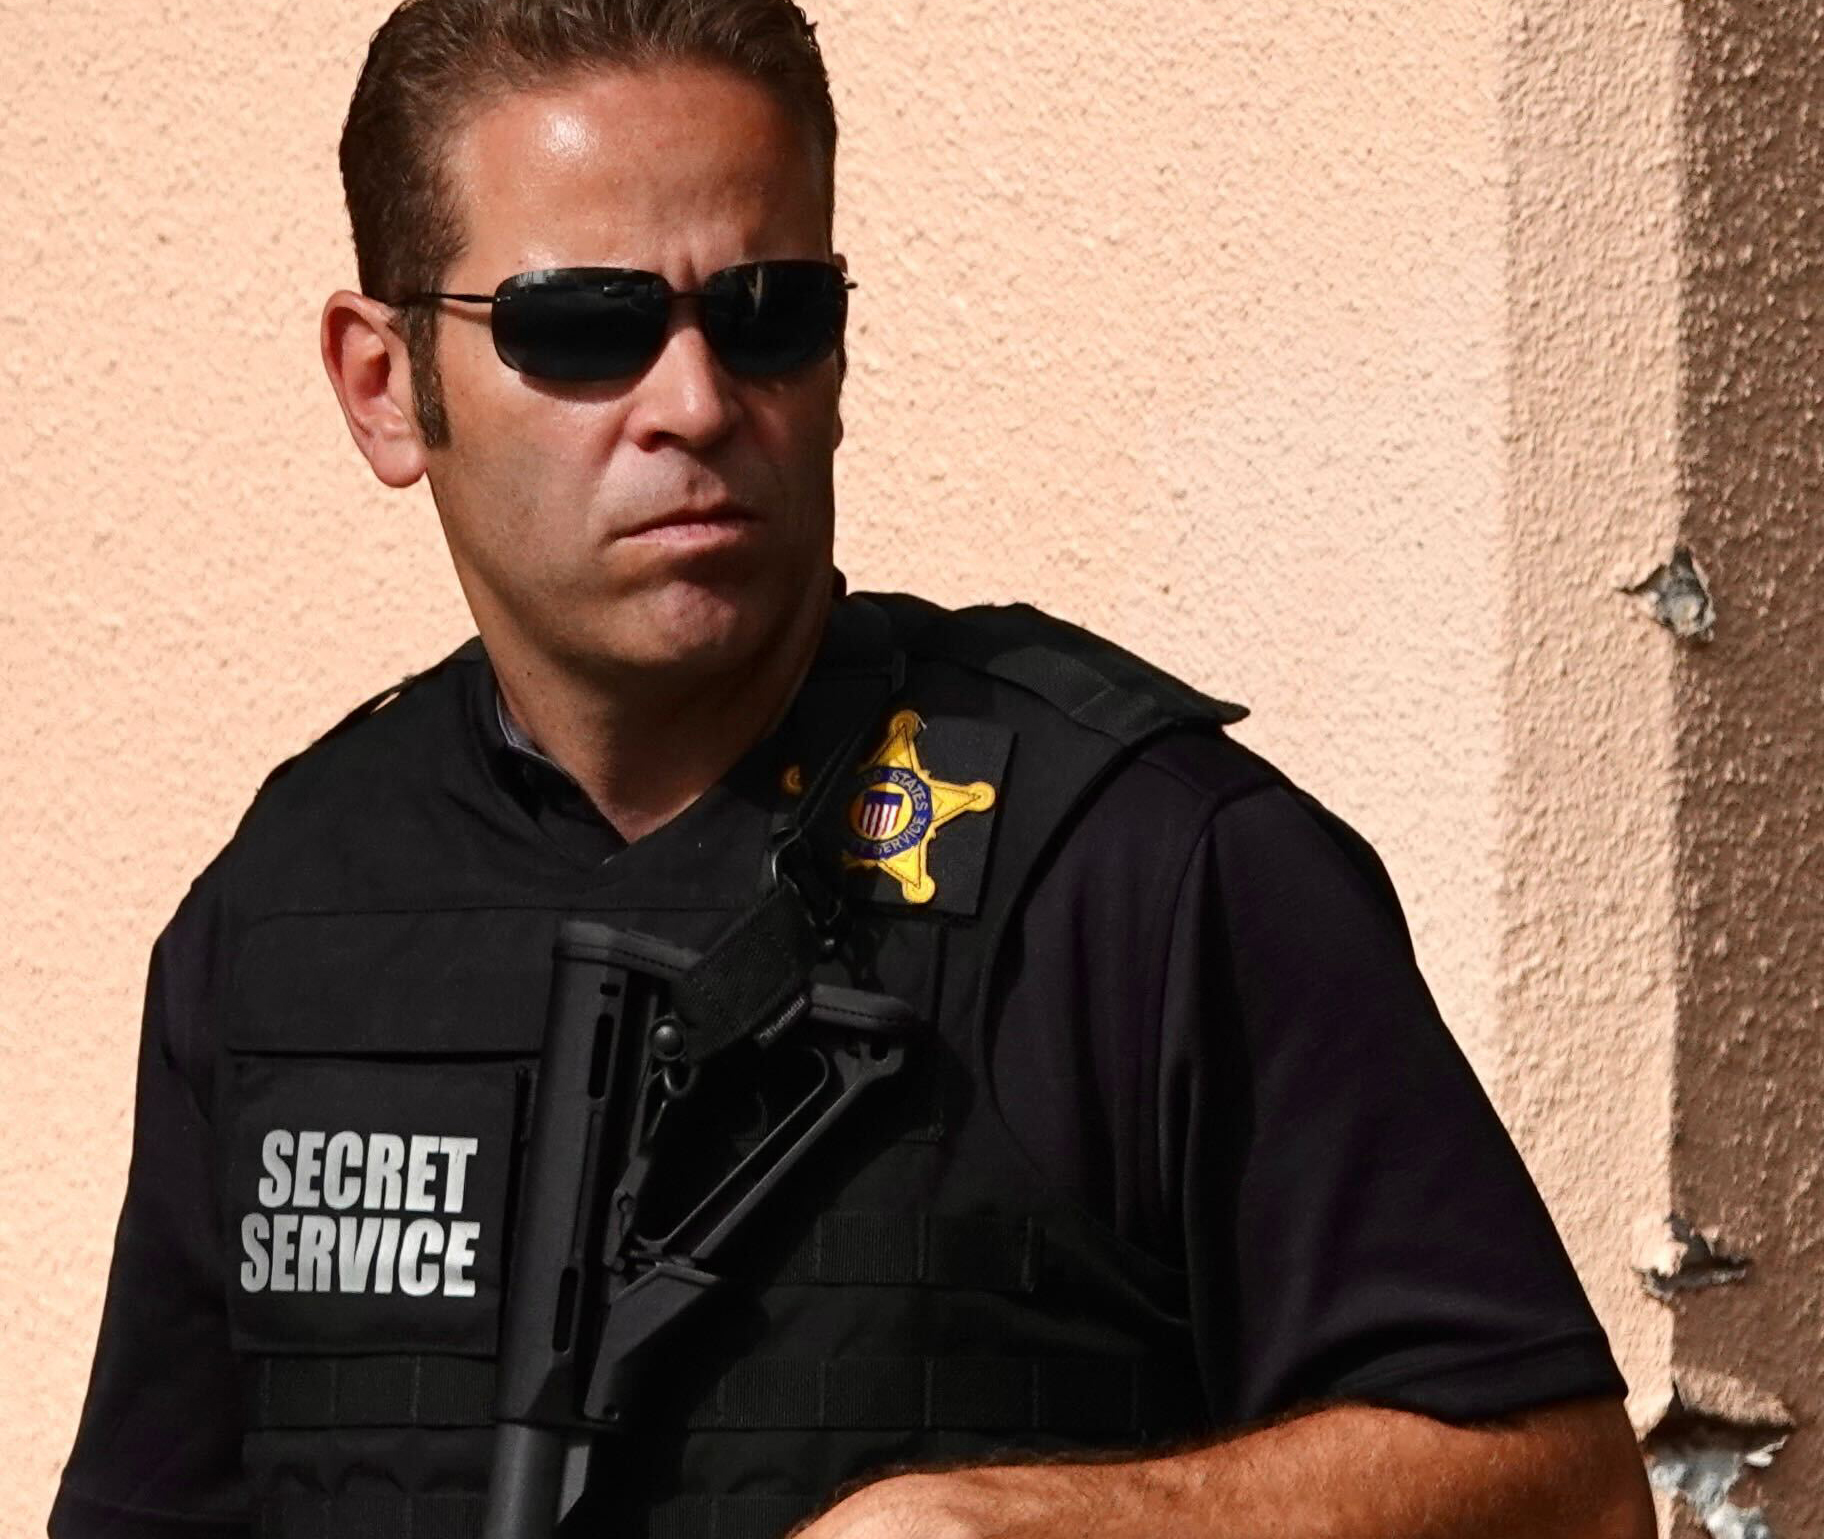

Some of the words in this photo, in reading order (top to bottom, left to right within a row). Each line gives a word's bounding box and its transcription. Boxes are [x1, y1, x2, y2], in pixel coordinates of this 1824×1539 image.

[889, 769, 929, 812] STATES
[258, 1129, 479, 1213] SECRET
[240, 1213, 481, 1298] SERVICE
